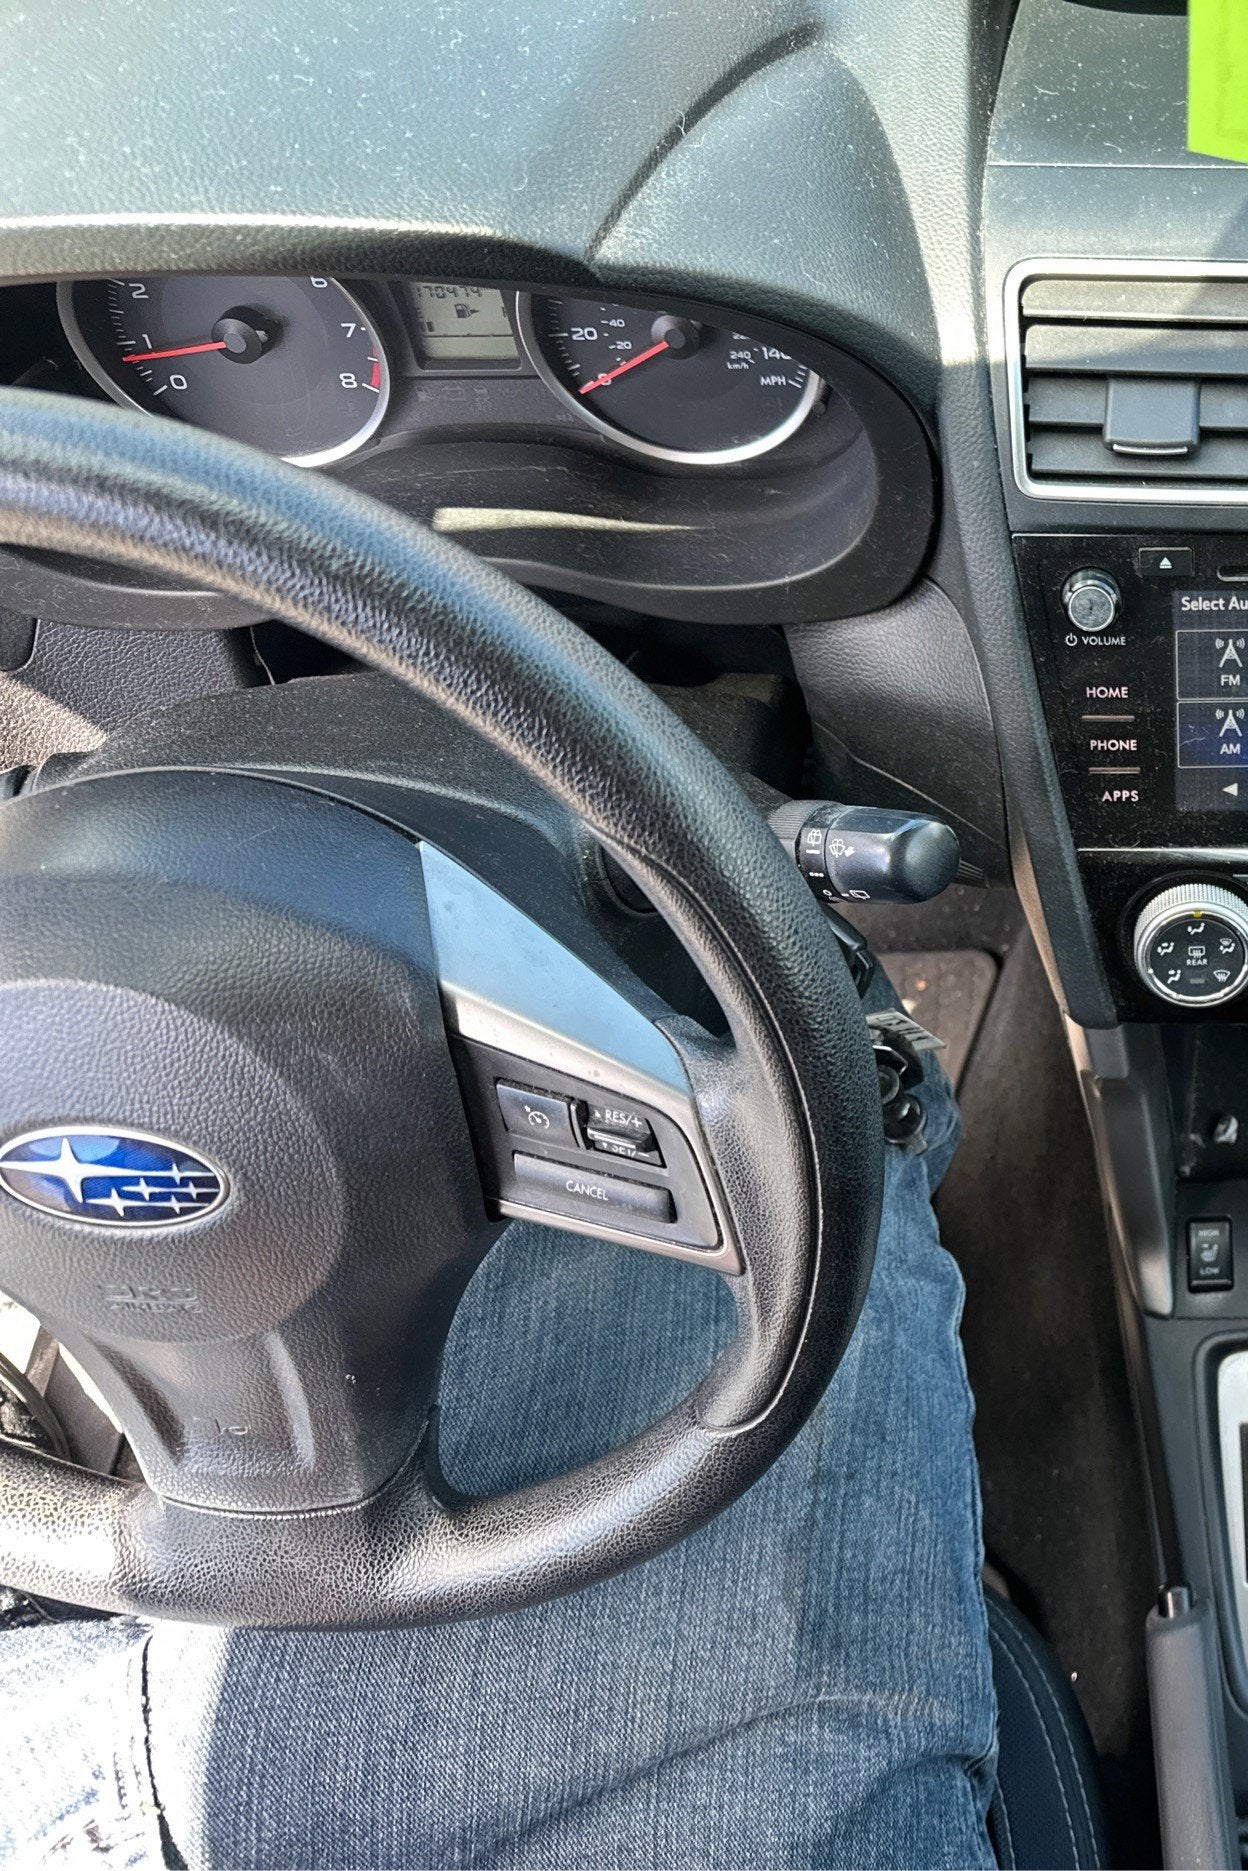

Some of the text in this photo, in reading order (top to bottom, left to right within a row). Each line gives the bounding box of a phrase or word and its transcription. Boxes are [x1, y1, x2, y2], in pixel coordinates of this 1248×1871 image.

[129, 283, 149, 299] 2
[609, 319, 626, 328] 40
[340, 323, 356, 338] 7
[571, 327, 598, 341] 20
[142, 333, 153, 349] 1
[616, 341, 632, 350] 20
[729, 350, 752, 360] 240
[726, 361, 750, 370] km/h
[170, 374, 187, 390] 0
[339, 373, 357, 388] 8
[760, 375, 787, 386] MPH
[1181, 596, 1225, 611] Select
[1082, 636, 1126, 646] VOLUME
[1220, 674, 1241, 686] FM
[1086, 686, 1129, 698] HOME
[1090, 740, 1138, 751] PHONE
[1219, 743, 1241, 755] AM
[1102, 790, 1139, 802] APPS
[1186, 958, 1208, 966] REAR
[605, 1108, 643, 1129] RES/+
[565, 1180, 609, 1201] CANCEL
[1199, 1267, 1220, 1275] LOW
